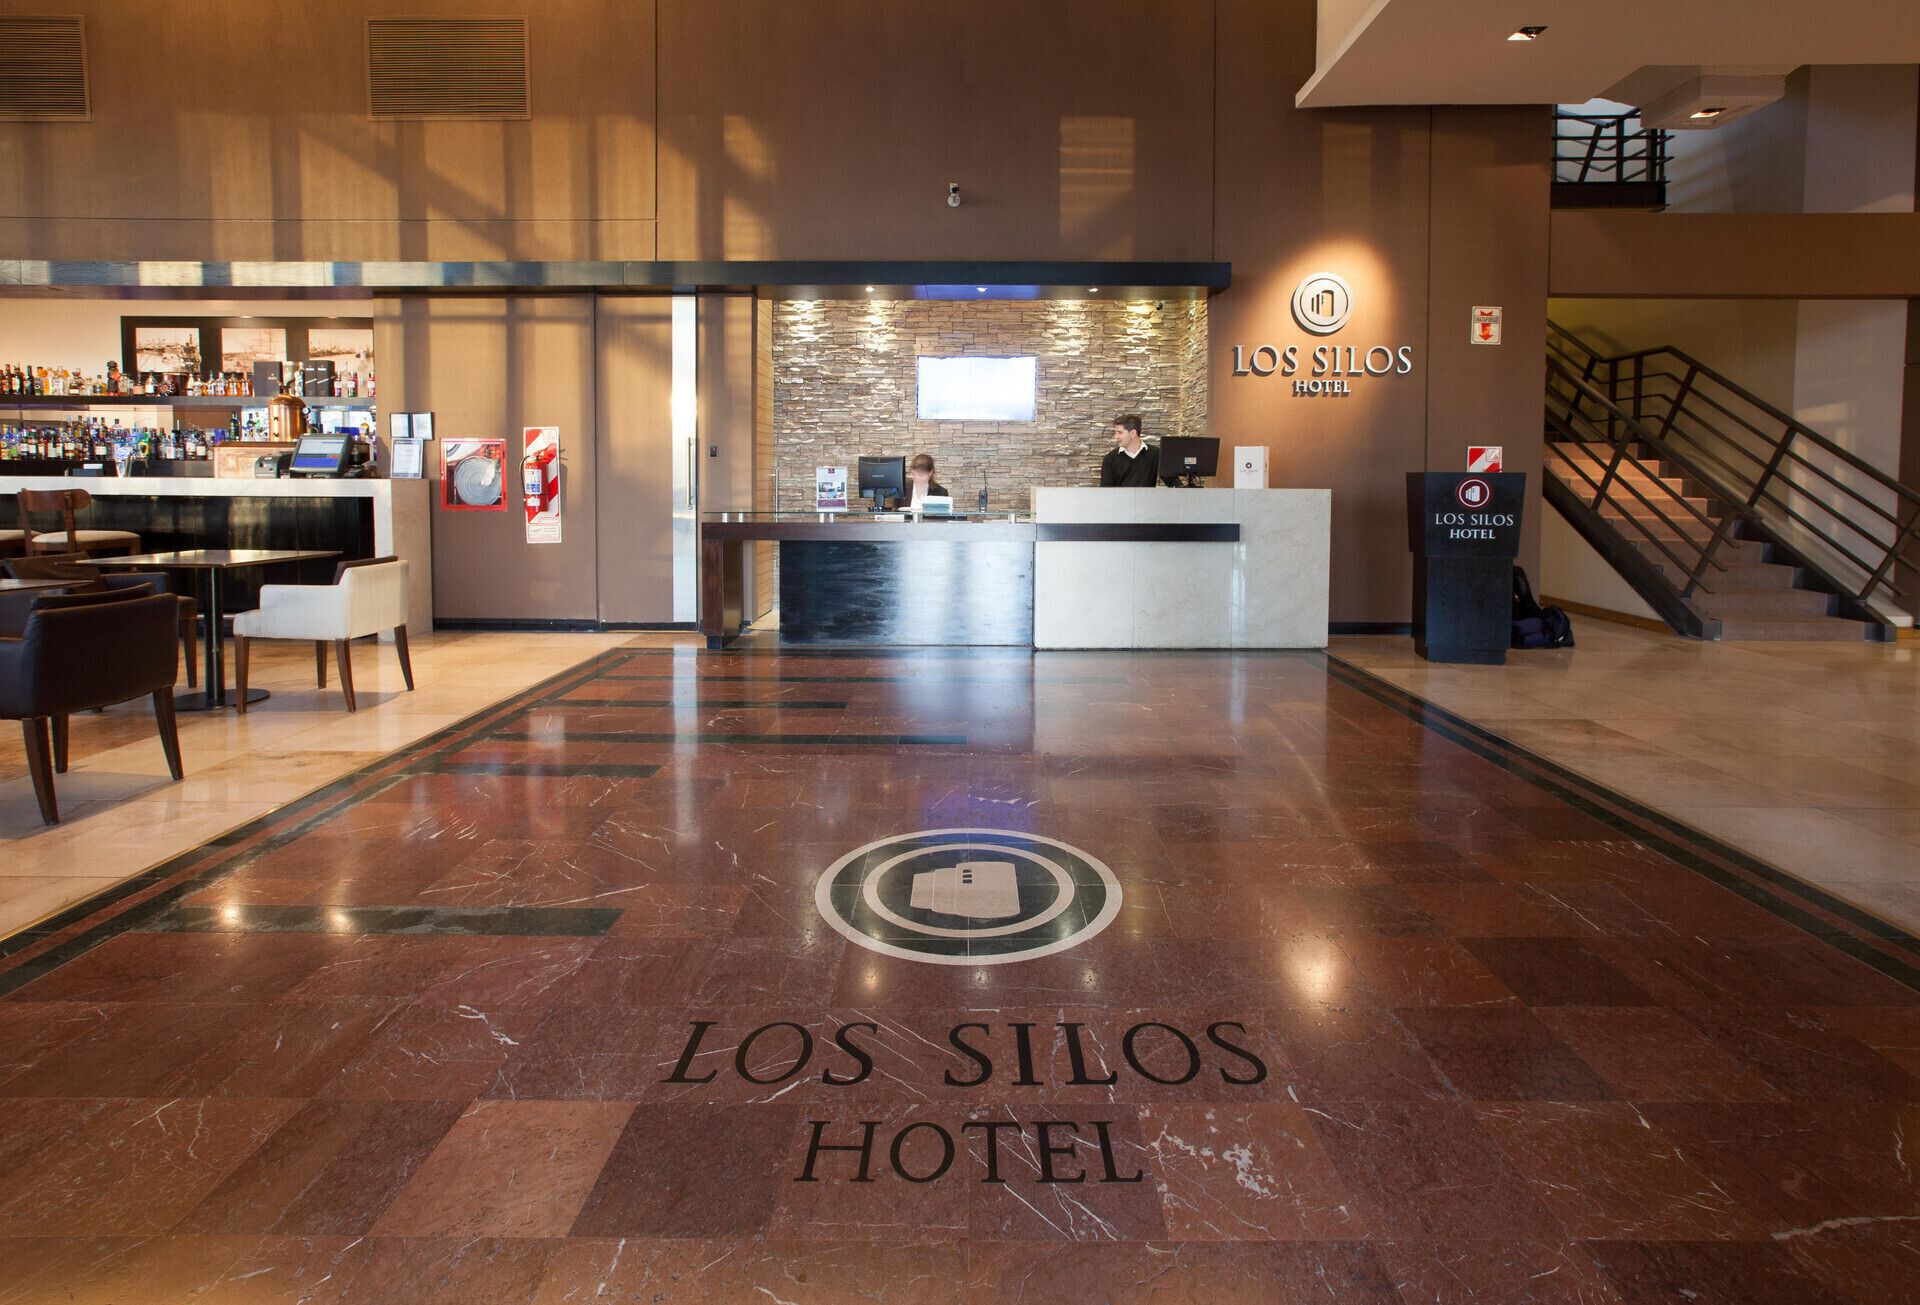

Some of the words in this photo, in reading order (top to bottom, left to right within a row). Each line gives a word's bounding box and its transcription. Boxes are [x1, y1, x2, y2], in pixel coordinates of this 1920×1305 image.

[1234, 344, 1300, 374] LOS
[1313, 345, 1413, 375] SILOS
[1294, 379, 1352, 394] HOTEL
[1435, 513, 1465, 525] LOS
[1470, 514, 1514, 526] SILOS
[1449, 528, 1496, 539] HOTEL
[660, 1021, 879, 1086] LOS
[943, 1021, 1268, 1087] SILOS
[793, 1120, 1144, 1184] HOTEL
